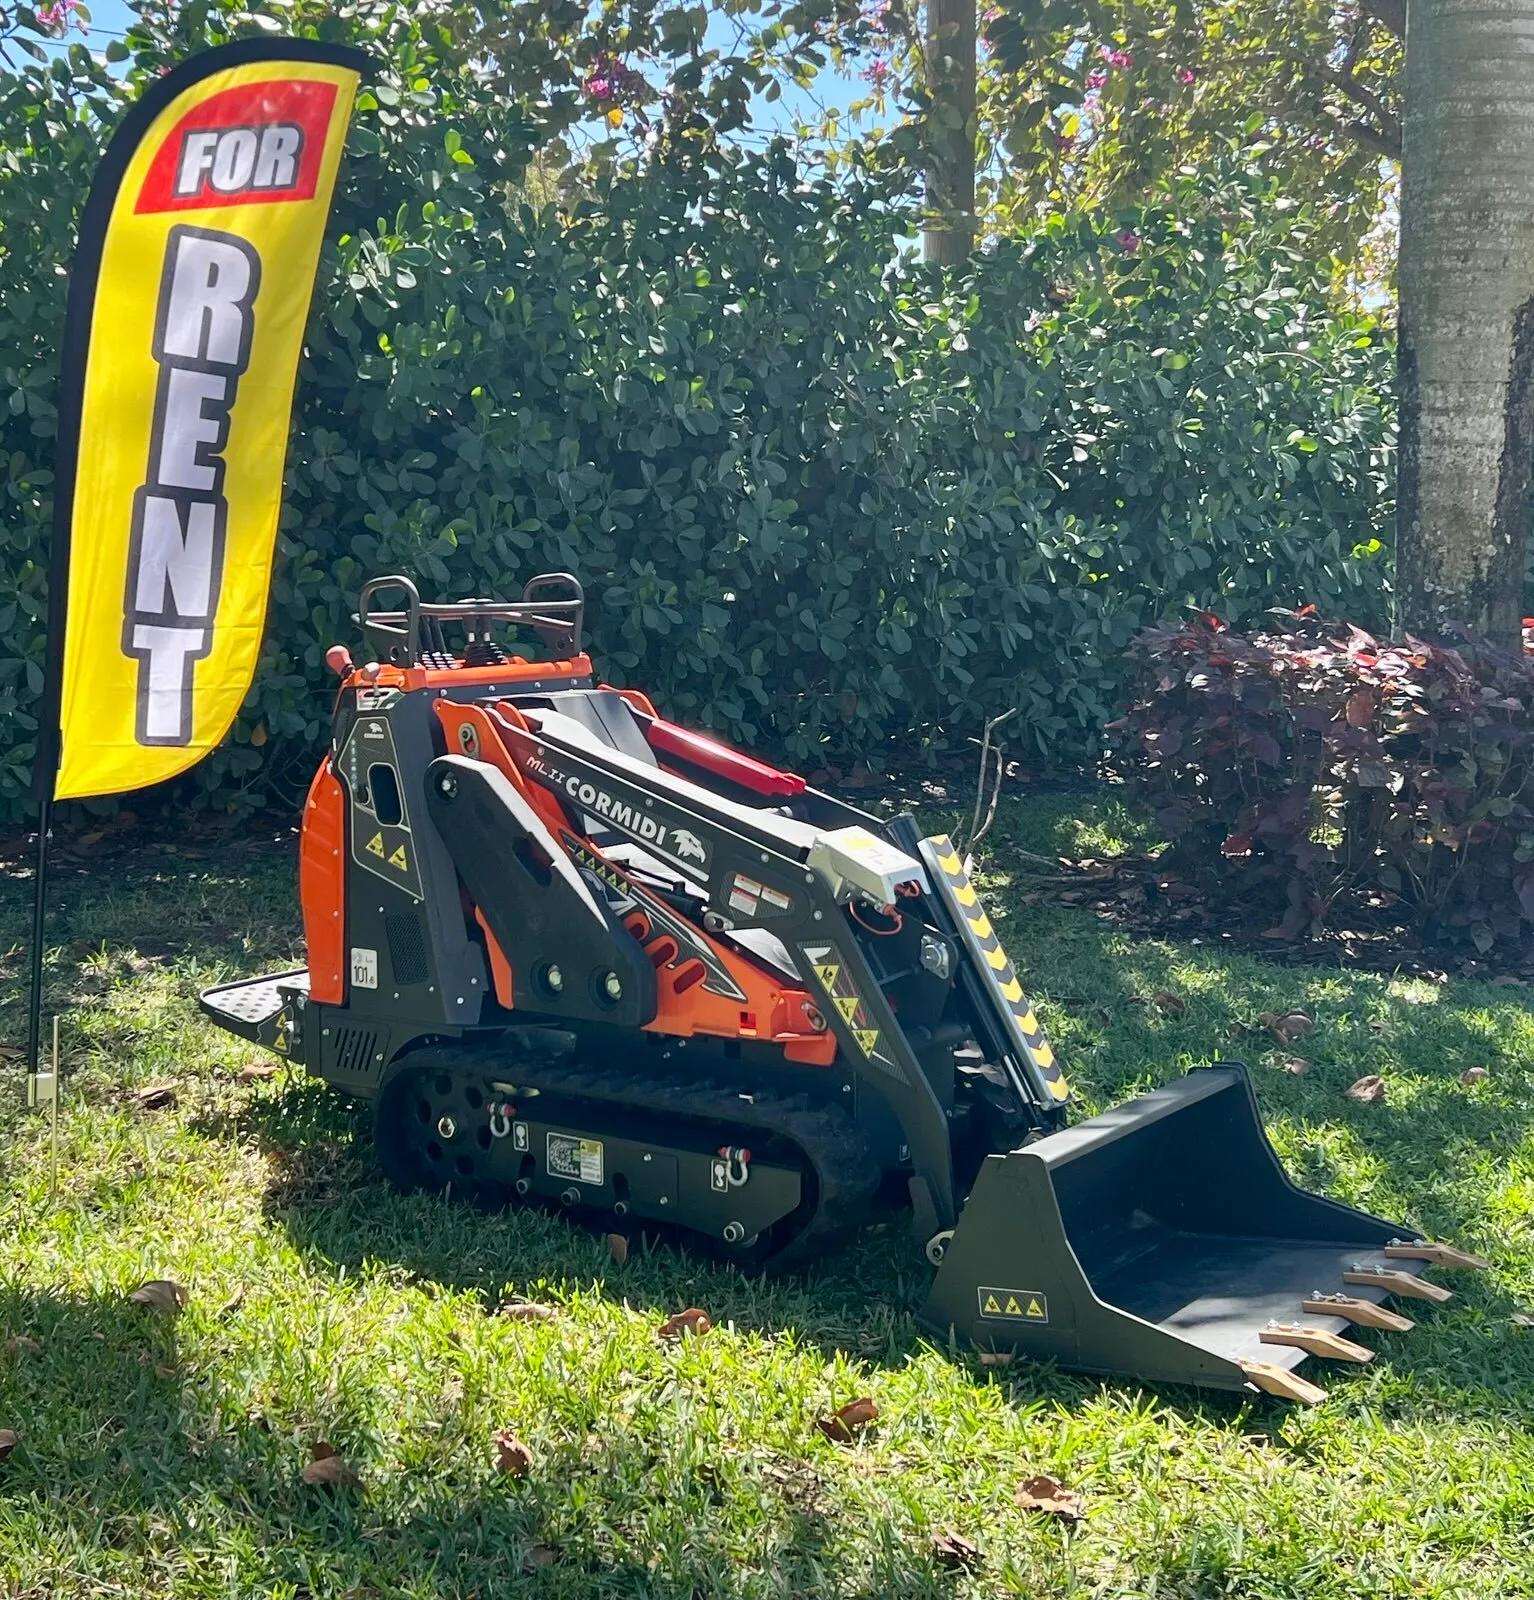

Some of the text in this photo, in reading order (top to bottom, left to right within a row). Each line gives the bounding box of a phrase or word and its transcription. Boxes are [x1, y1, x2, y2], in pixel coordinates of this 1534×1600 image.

[176, 124, 301, 196] FOR
[129, 230, 256, 742] RENT
[565, 776, 667, 846] CORMIDI
[353, 965, 368, 984] 101
